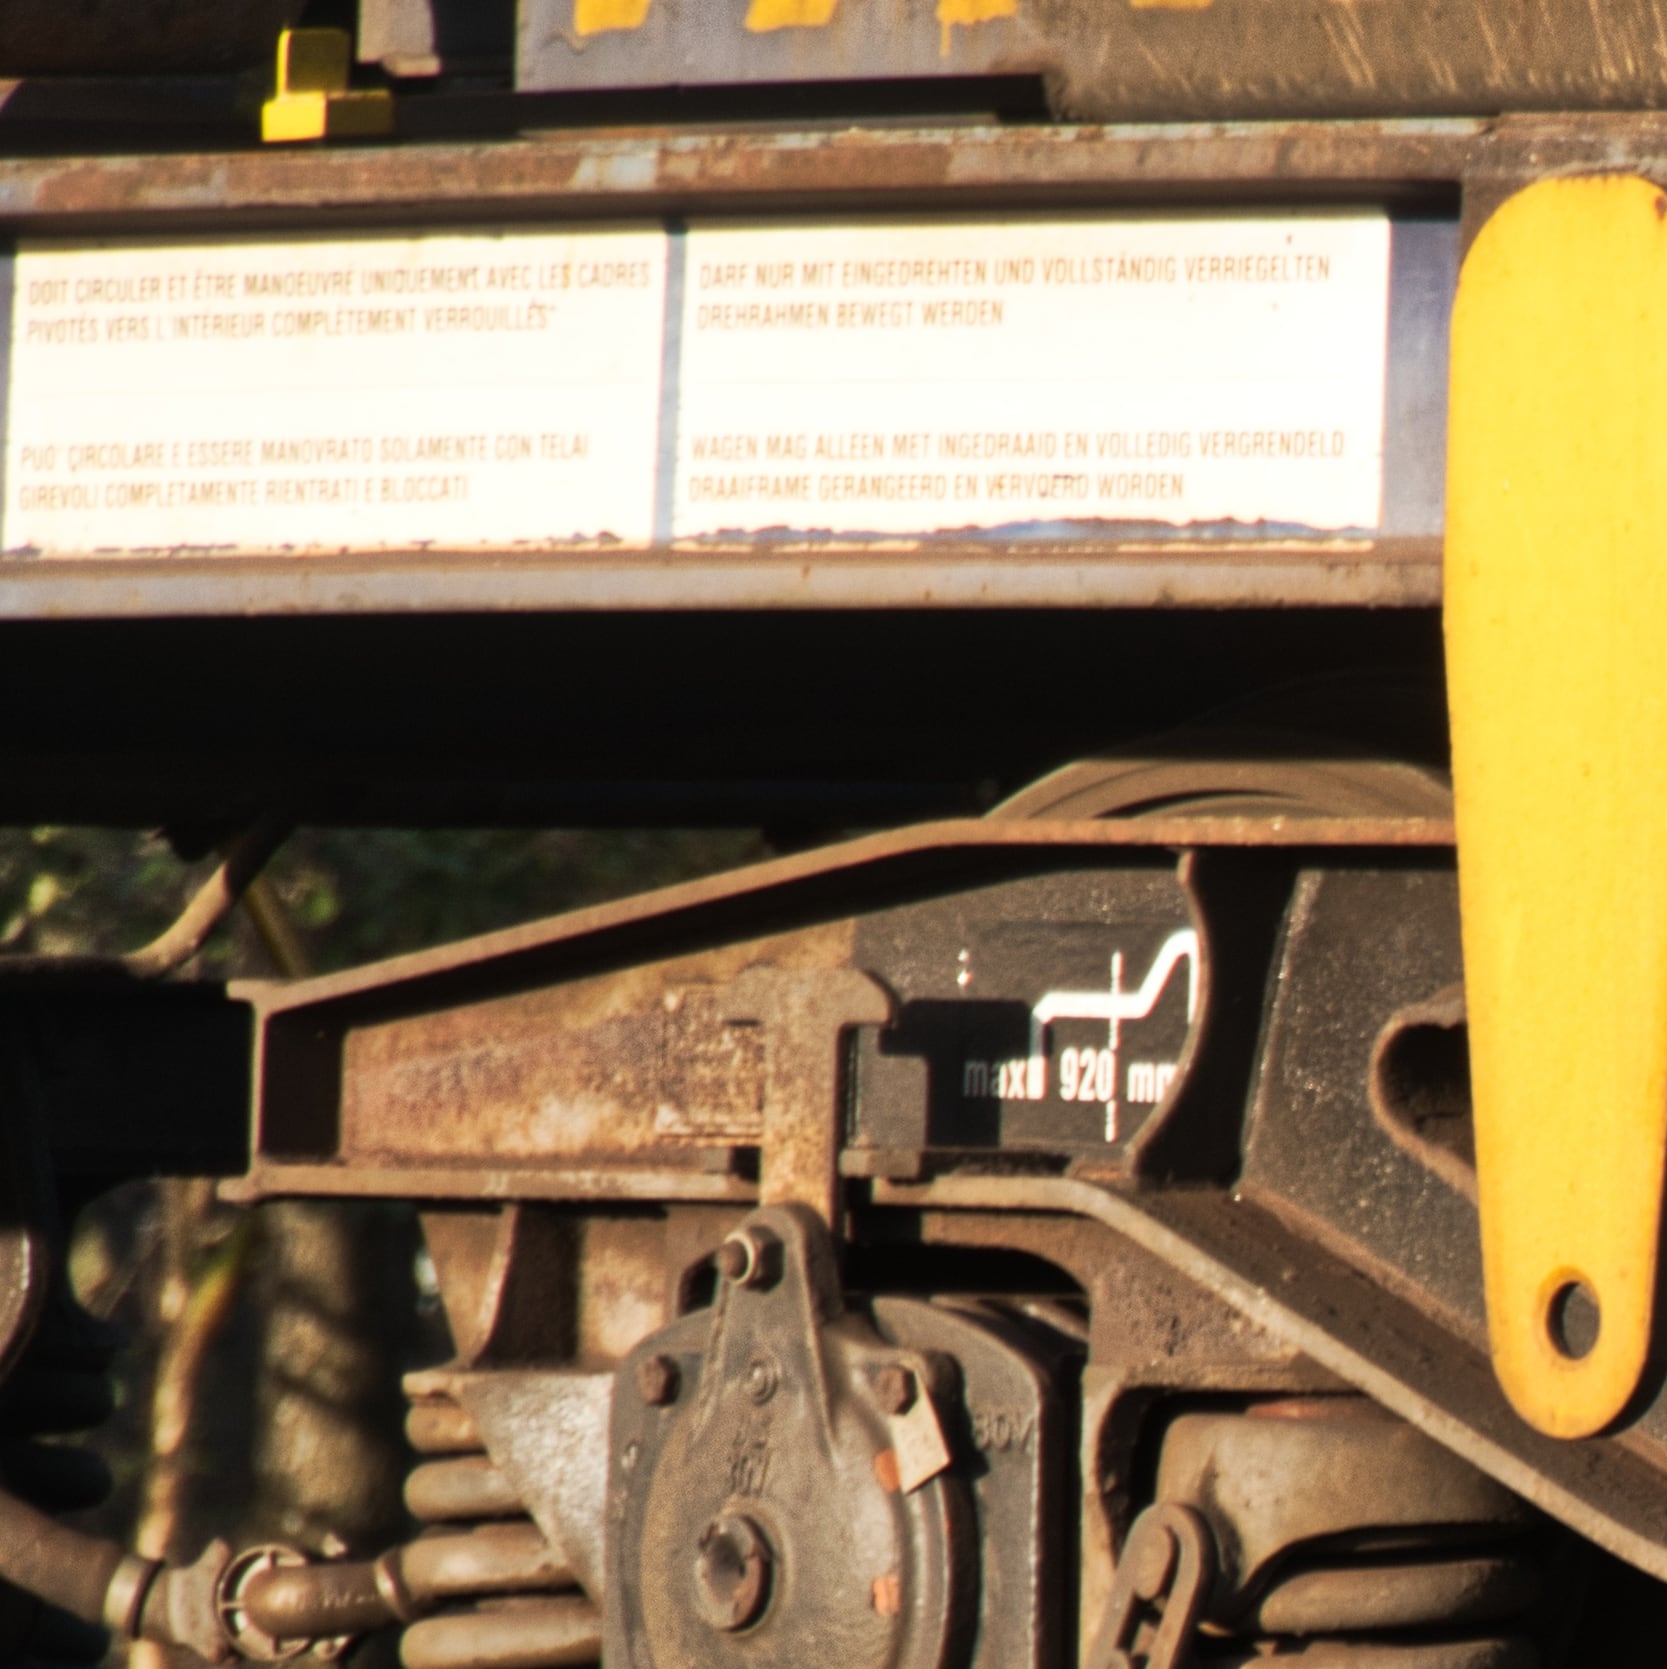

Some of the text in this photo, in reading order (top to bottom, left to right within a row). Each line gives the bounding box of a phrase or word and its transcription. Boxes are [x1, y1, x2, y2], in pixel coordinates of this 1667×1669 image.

[29, 278, 68, 306] DOIT
[74, 275, 162, 304] CIRCULER
[167, 275, 187, 301] ET
[193, 267, 237, 300] ÊTRE
[361, 264, 480, 294] UNIQUEMENT
[486, 264, 532, 291] AVEC
[538, 263, 572, 290] LES
[577, 261, 650, 289] CADRES
[701, 262, 748, 290] DARF
[755, 262, 794, 289] NUR
[802, 261, 834, 288] MIT
[842, 259, 987, 288] EINGEDREHTEN
[993, 257, 1035, 286] UND
[1185, 255, 1331, 283] VERRIEGELTEN
[106, 314, 149, 342] VERS
[697, 299, 1004, 330] DREHRAHMEN BEWEGT WERDEN
[187, 440, 254, 468] ESSERE
[261, 437, 373, 465] MANOVRATO
[380, 434, 487, 463] SOLAMENTE
[496, 433, 532, 461] CON
[540, 431, 590, 460] TELAI
[692, 433, 758, 461] WAGEN
[766, 433, 807, 460] MAG
[893, 432, 930, 459] MET
[938, 431, 1057, 460] INGEDRAAID
[1063, 431, 1088, 458] EN
[1096, 431, 1191, 459] VOLLEDIG
[1199, 429, 1343, 458] VERGRENDELD
[20, 474, 469, 511] GIREVOLI COMPLETAMENTE RIENTRATI E BLOCCATI
[690, 472, 1184, 502] DRAAIFRAME GERANGEERD EN VERVOERD WORDEN
[1060, 1047, 1115, 1102] 920
